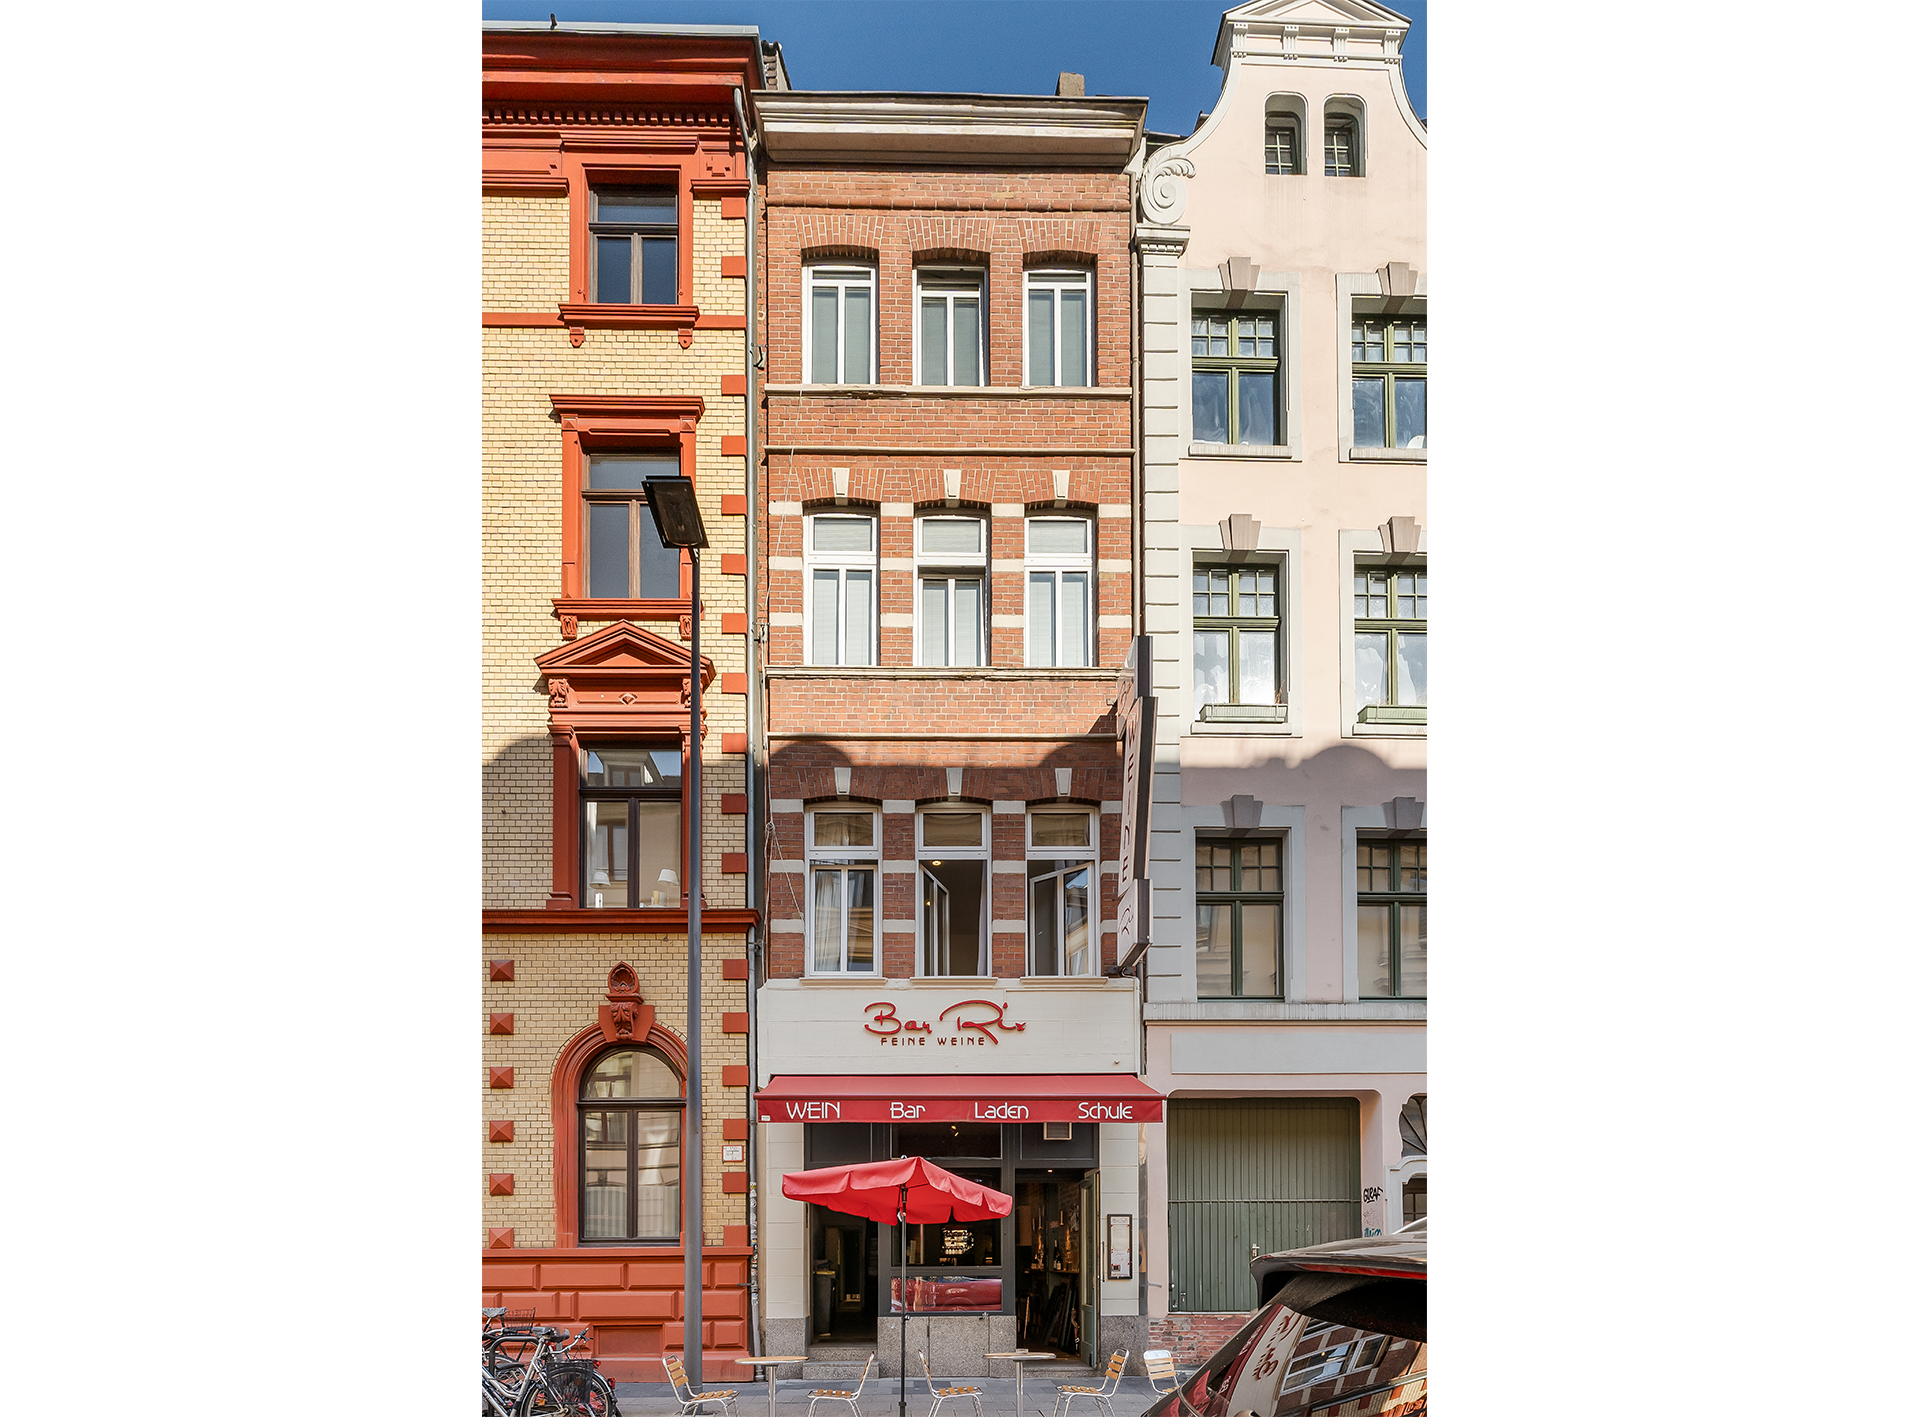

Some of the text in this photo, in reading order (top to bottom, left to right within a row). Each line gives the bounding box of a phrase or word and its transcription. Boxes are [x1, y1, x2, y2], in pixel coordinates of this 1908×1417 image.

[865, 1000, 1026, 1045] Bar Rix
[881, 1037, 985, 1046] FEINE WEINE
[786, 1102, 1133, 1119] WEIN Bar Laden Schule
